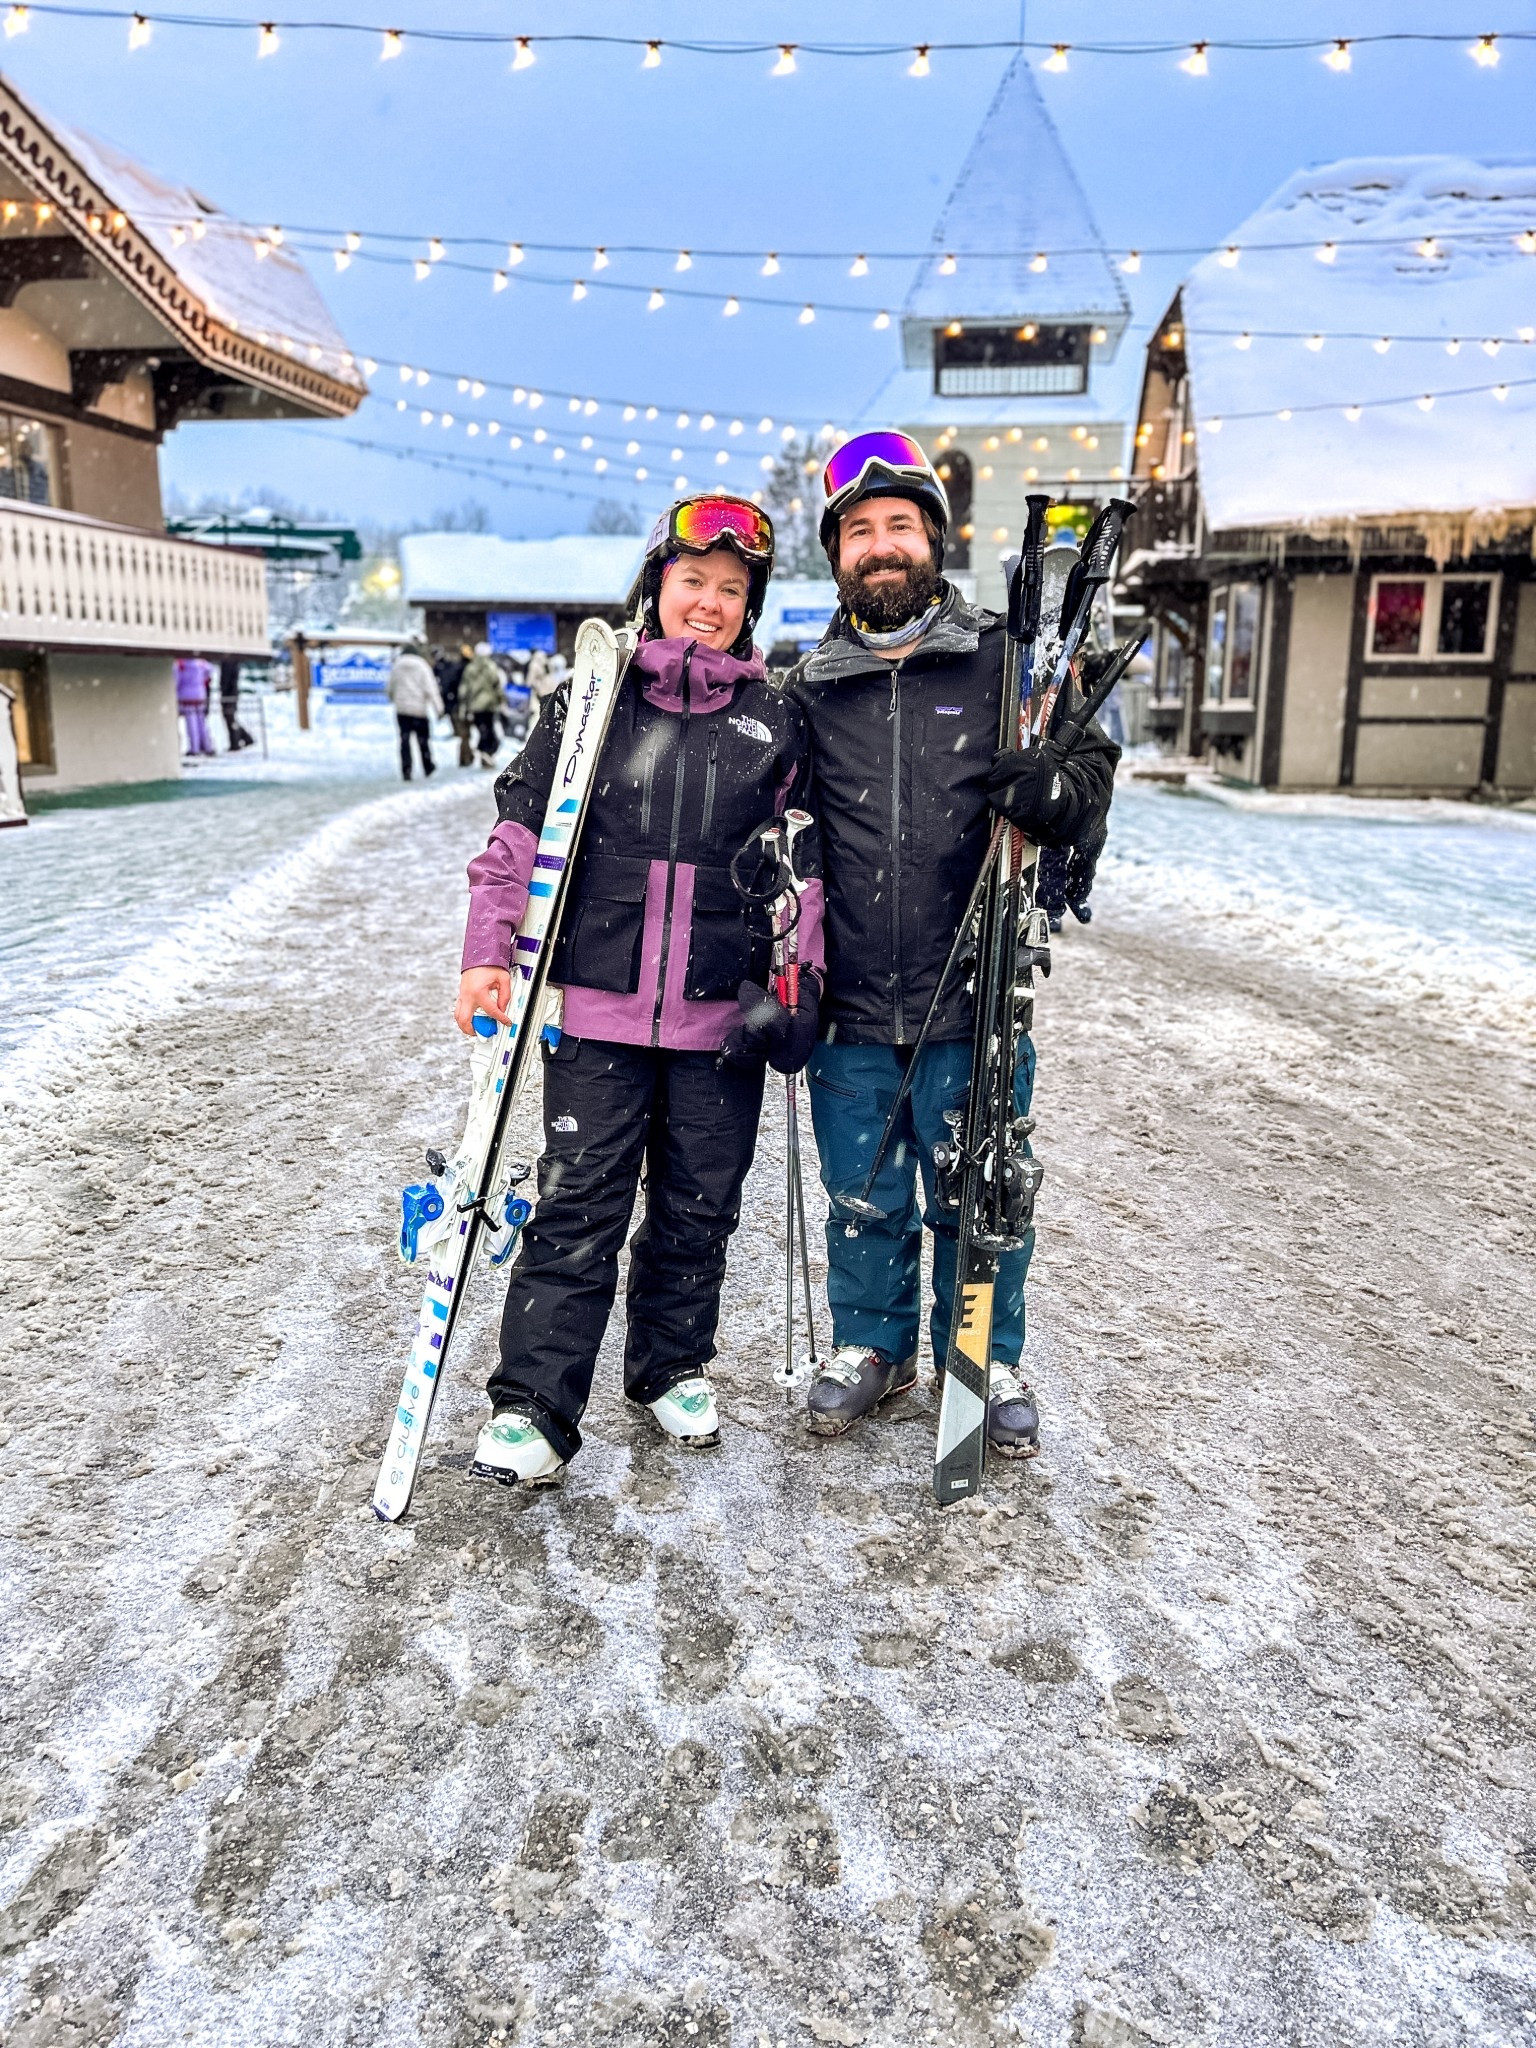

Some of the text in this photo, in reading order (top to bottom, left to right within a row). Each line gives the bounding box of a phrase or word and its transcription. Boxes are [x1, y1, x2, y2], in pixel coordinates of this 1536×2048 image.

[728, 716, 757, 732] NORTH
[741, 714, 757, 726] THE
[563, 669, 597, 788] Dynastar
[737, 724, 758, 740] FACE
[391, 1385, 420, 1485] eclusive
